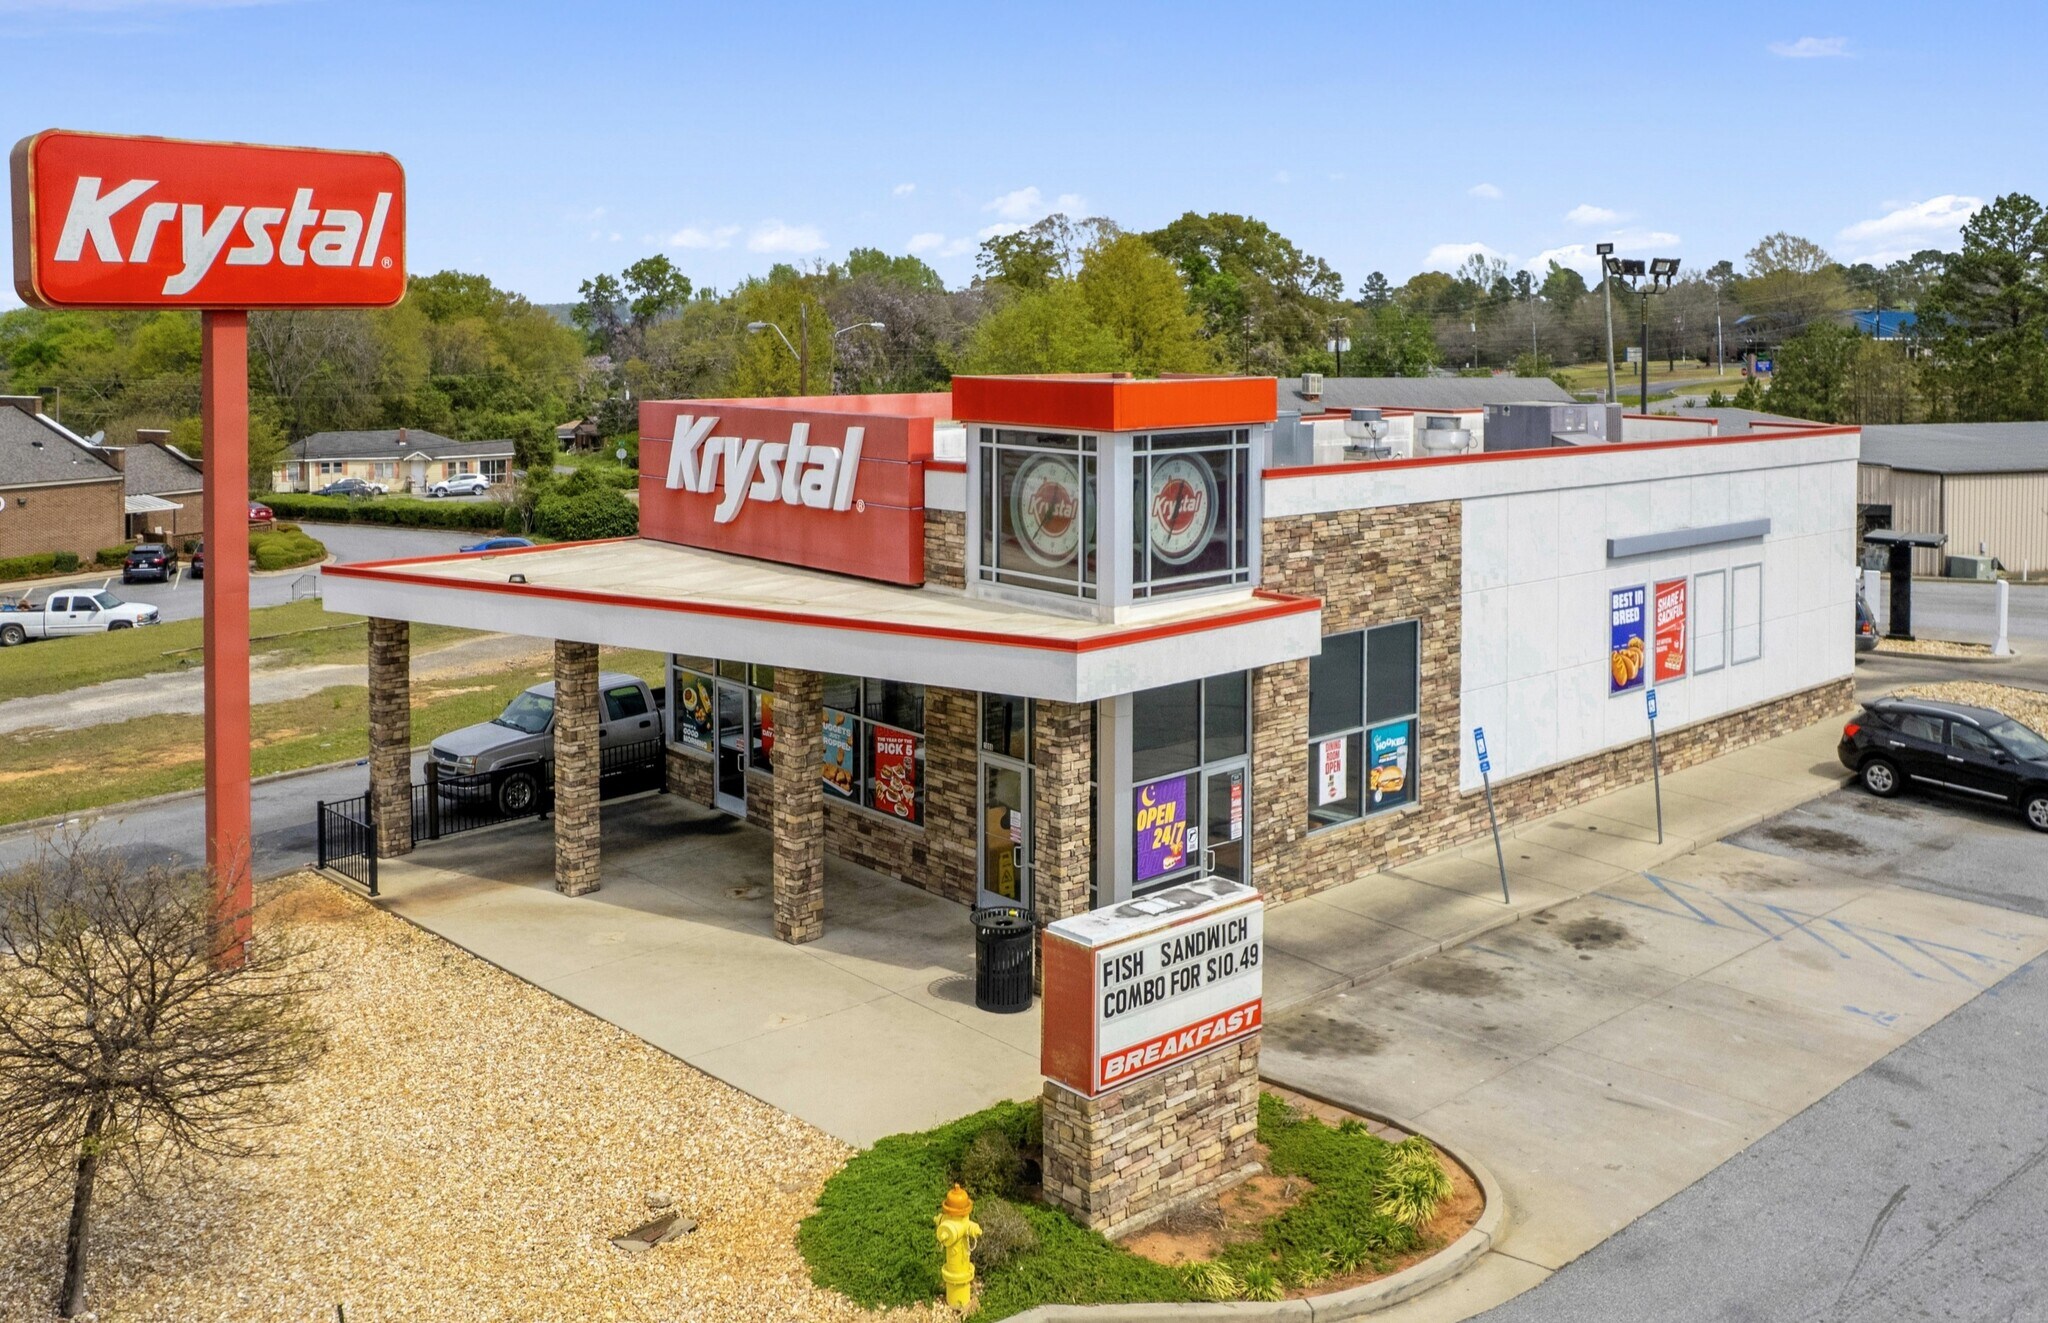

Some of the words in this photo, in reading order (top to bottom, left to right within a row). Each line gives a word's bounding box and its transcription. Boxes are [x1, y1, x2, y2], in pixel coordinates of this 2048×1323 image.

[54, 176, 392, 295] Krystal
[666, 414, 865, 523] Krystal
[1612, 591, 1633, 609] BEST
[1635, 590, 1643, 605] IN
[1657, 590, 1679, 613] SHARE
[1679, 588, 1684, 602] A
[1612, 607, 1640, 626] BREED
[1657, 603, 1684, 627] SACKFUL
[683, 727, 699, 738] GOOD
[822, 721, 851, 737] UGGETS
[822, 736, 851, 751] ROPPED
[877, 742, 903, 755] PICK
[906, 745, 913, 756] 5
[1325, 740, 1341, 752] DINING
[1375, 736, 1406, 751] HOOKED
[1326, 750, 1340, 761] ROOM
[1325, 759, 1341, 775] OPEN
[1137, 801, 1176, 831] OPEN
[1152, 821, 1186, 849] 24/7
[1103, 950, 1144, 987] FISH
[1161, 917, 1247, 967] SANDWICH
[1104, 976, 1165, 1018] COMBO
[1170, 963, 1200, 996] FOR
[1104, 1004, 1258, 1080] BREAKFAST
